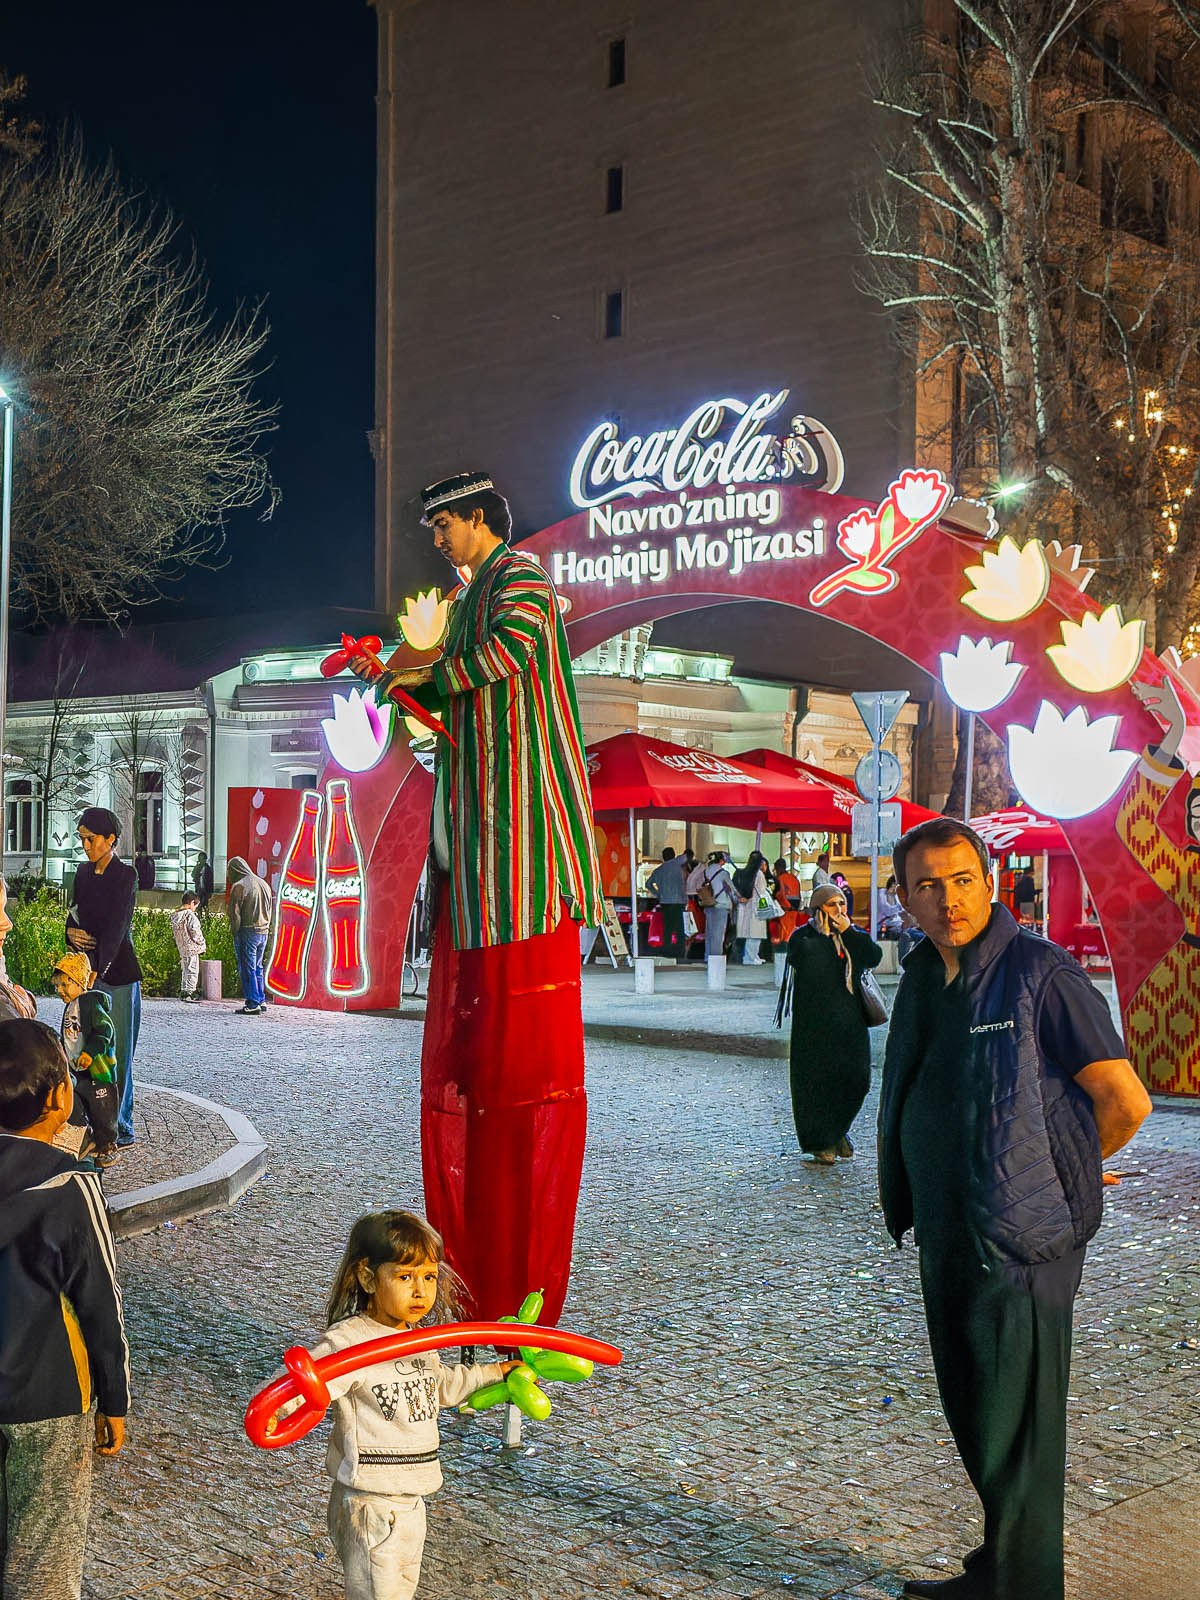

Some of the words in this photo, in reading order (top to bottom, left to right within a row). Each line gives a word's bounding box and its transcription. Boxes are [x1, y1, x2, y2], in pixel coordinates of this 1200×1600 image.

[570, 388, 790, 509] Coca-Cola
[588, 485, 781, 540] Navro'zning
[552, 541, 669, 587] Haqiqiy
[675, 518, 825, 576] Mo'jizasi
